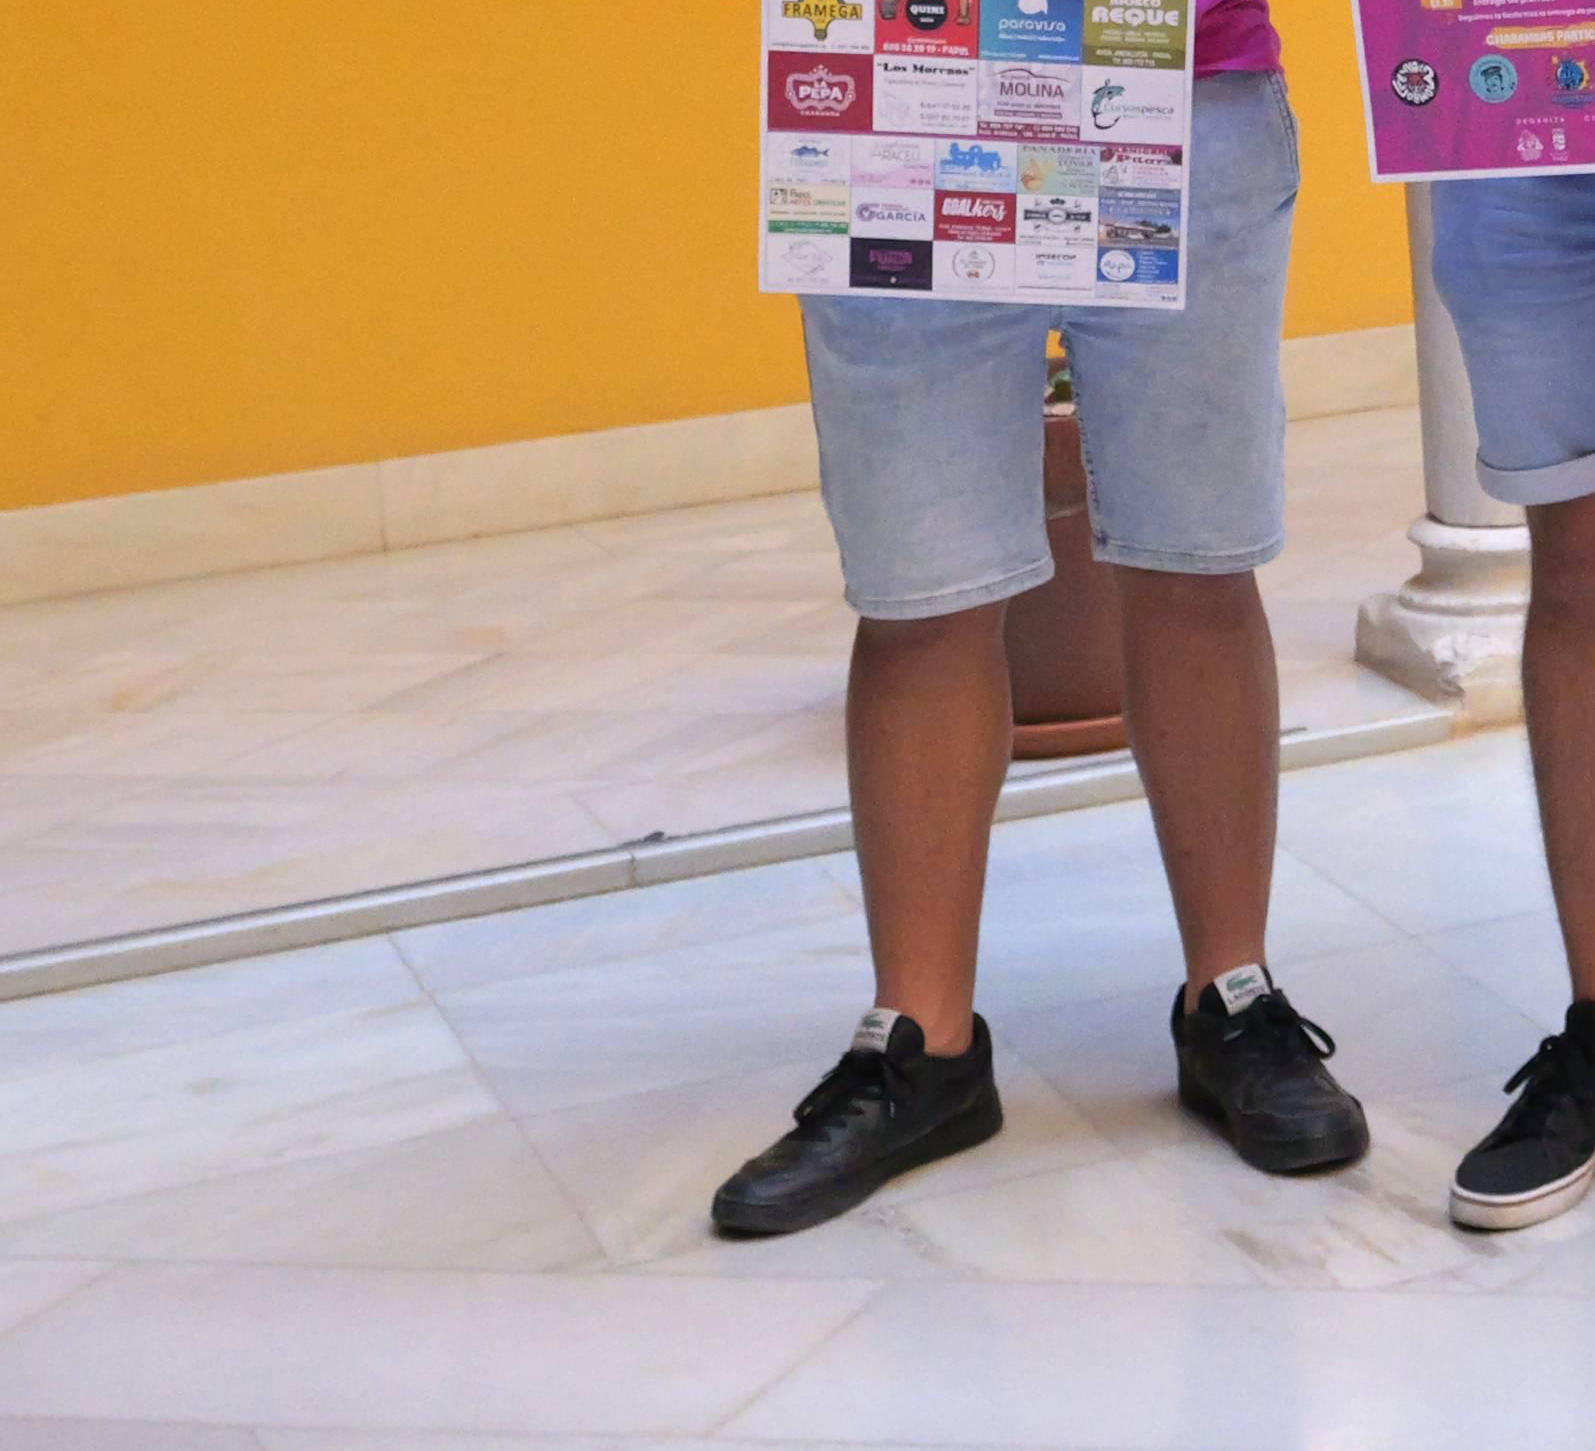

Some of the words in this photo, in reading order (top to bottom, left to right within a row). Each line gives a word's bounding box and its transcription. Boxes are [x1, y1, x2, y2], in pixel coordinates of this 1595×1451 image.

[783, 1, 863, 20] FRAMEGA
[798, 85, 843, 101] PEPA
[1000, 81, 1065, 99] MOLINA
